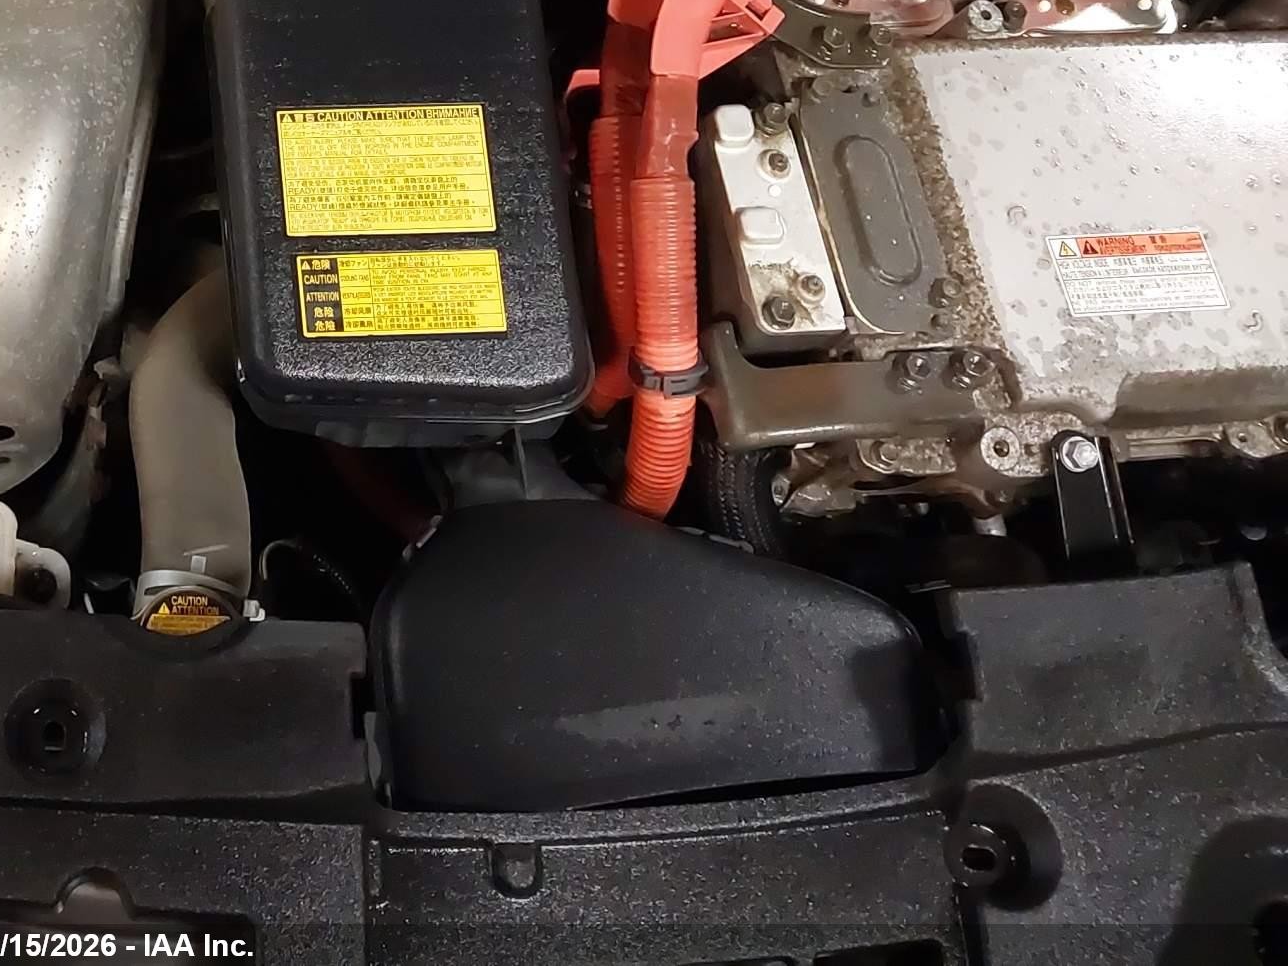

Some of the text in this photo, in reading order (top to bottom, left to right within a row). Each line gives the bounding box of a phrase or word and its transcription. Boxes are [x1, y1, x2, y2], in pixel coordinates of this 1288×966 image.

[317, 111, 363, 122] CAUTION
[366, 109, 424, 121] ATTENTION
[426, 108, 478, 119] ВНИМАНИЕ
[1096, 236, 1135, 246] WARNING
[304, 274, 338, 285] CAUTION
[306, 291, 339, 303] ATTENTION
[171, 595, 208, 606] CAUTION
[171, 605, 219, 615] ATTENTION
